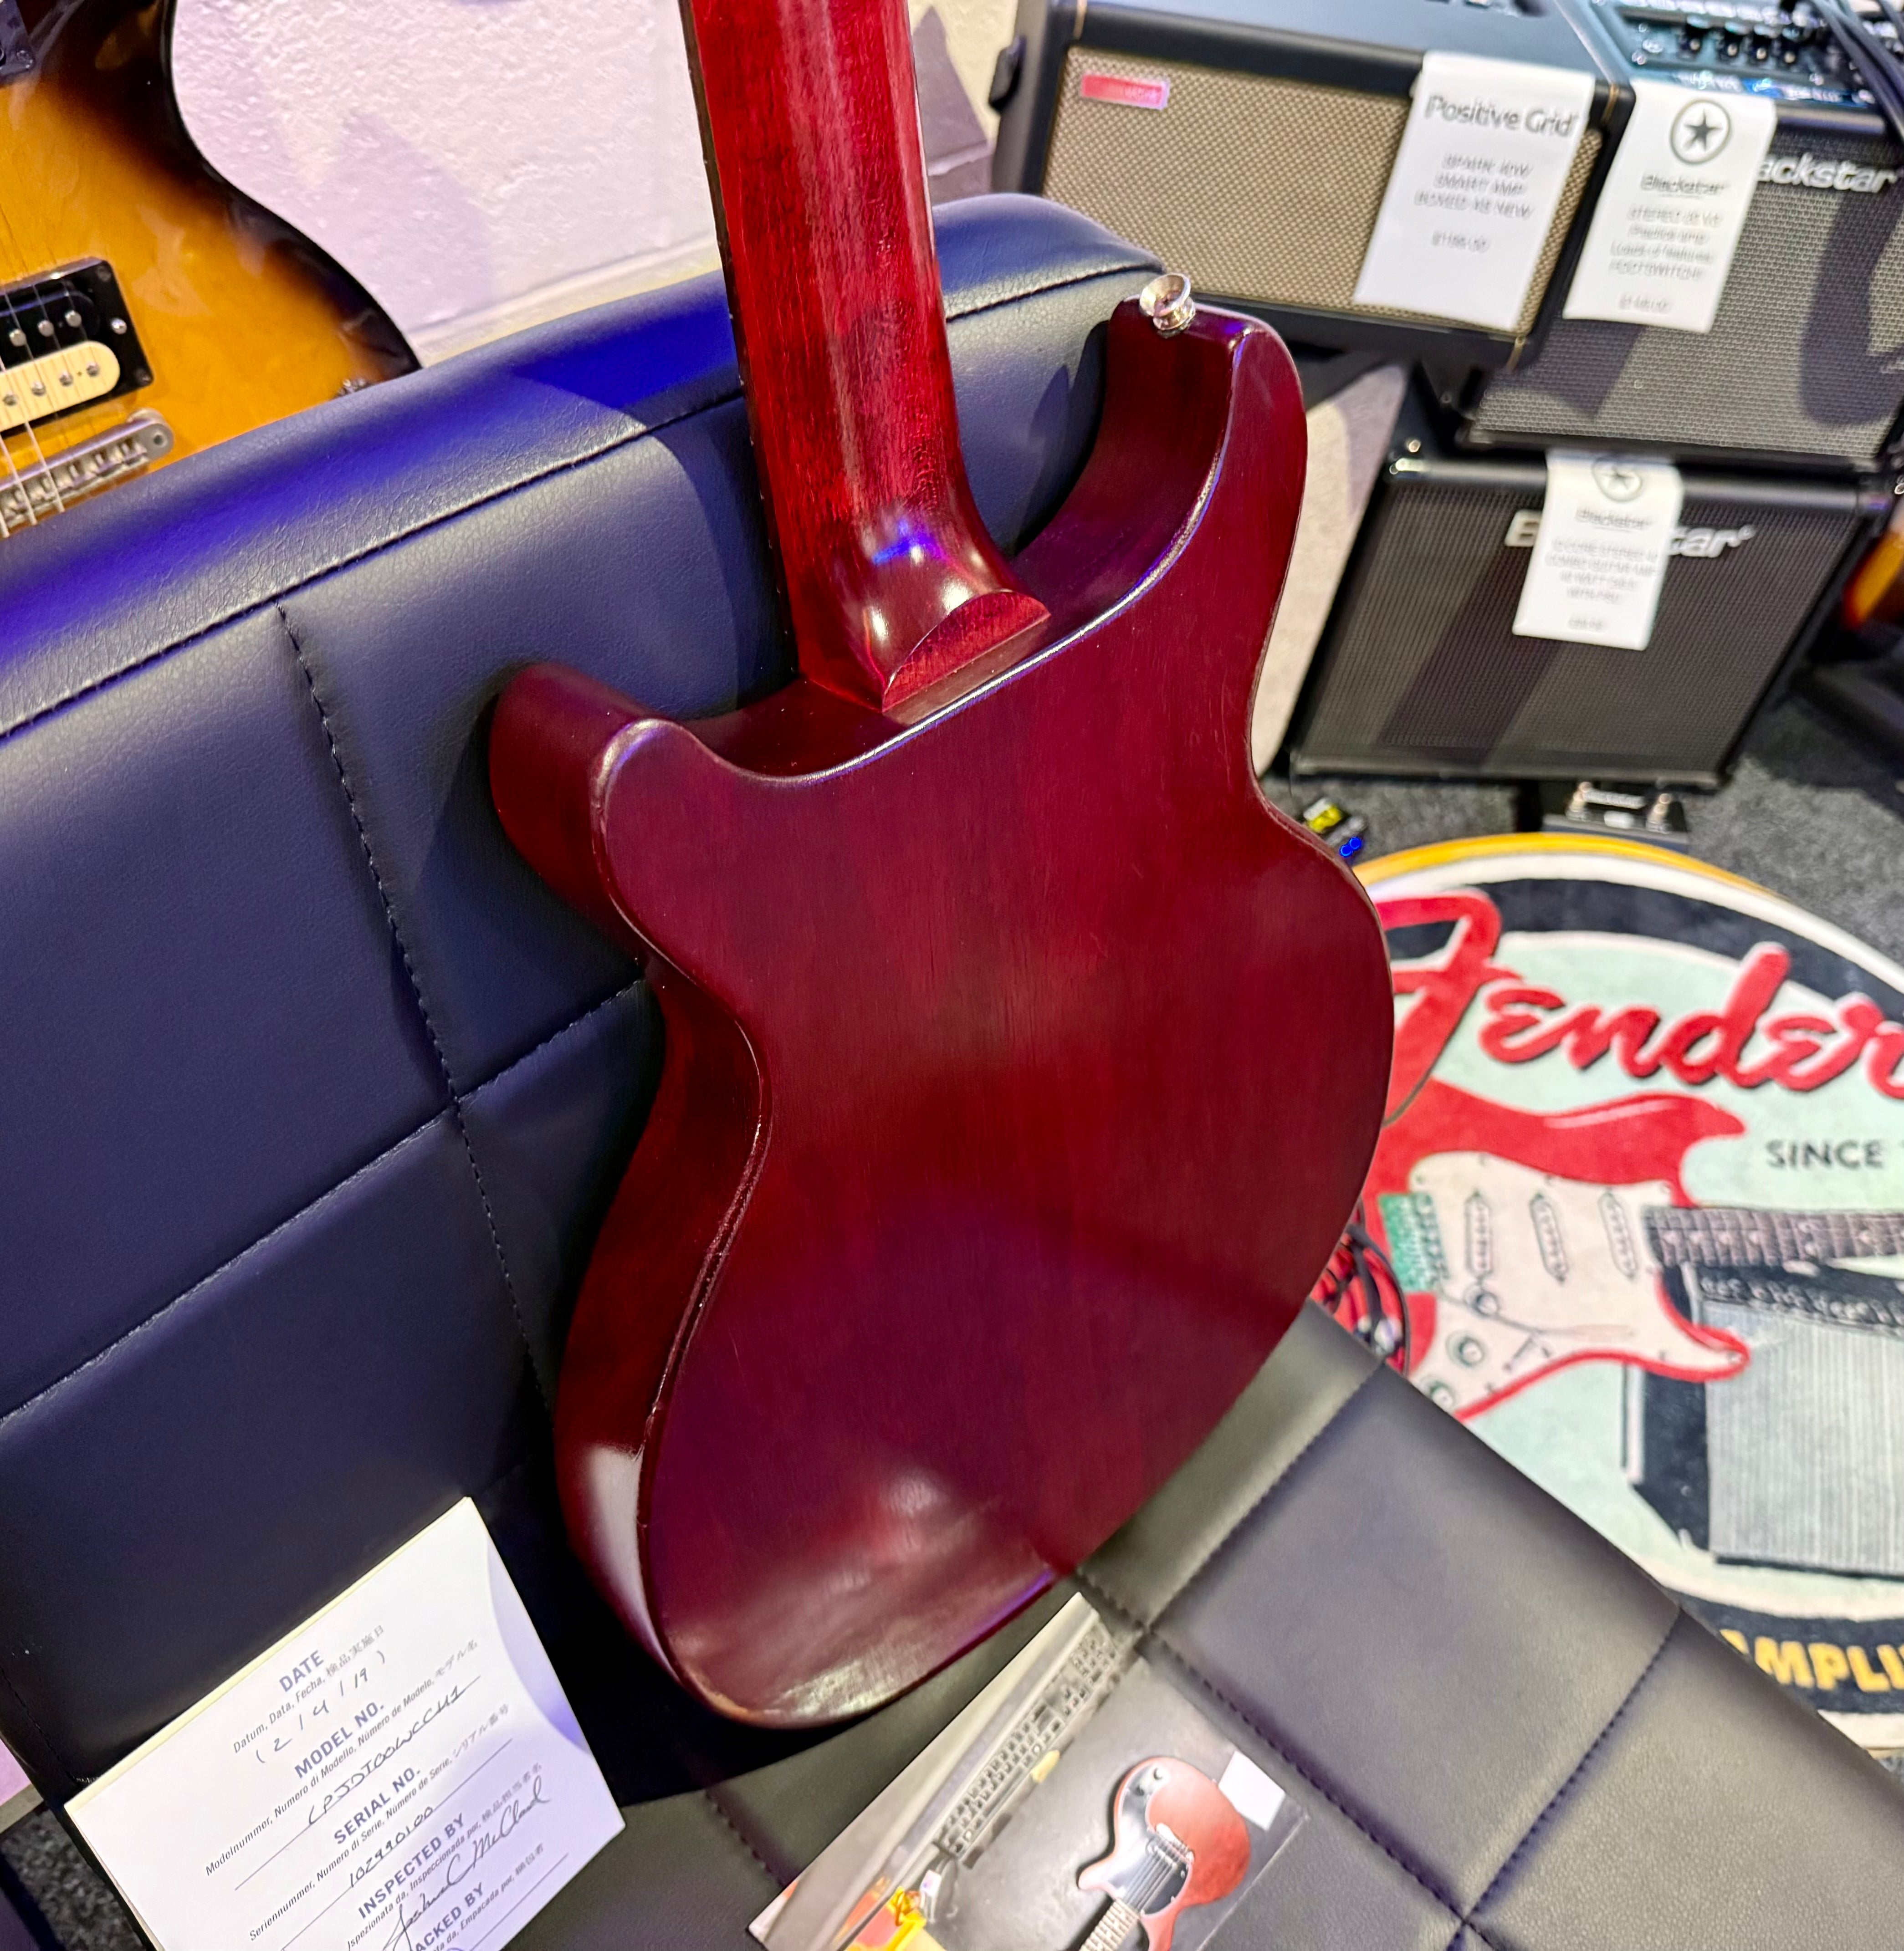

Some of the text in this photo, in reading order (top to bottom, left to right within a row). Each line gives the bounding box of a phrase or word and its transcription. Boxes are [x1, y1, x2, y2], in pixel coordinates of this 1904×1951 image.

[1424, 95, 1576, 137] Positive Grid
[1641, 173, 1725, 196] Blackstar
[1576, 507, 1650, 529] Blackstar
[1380, 888, 1904, 1101] Fender
[1765, 1139, 1884, 1170] SINCE
[279, 1650, 324, 1692] DATE
[233, 1724, 268, 1753] Datum,
[269, 1702, 294, 1725] Data,
[296, 1677, 325, 1703] Fecha,
[294, 1702, 384, 1778] MODEL NO.
[206, 1639, 478, 1876] Modelnummer, Numero di Modello, Número de Modelo, モデル名
[334, 1768, 420, 1844] SERIAL NO.
[250, 1882, 315, 1941] Seriennummer,
[317, 1849, 349, 1882] Numero
[351, 1839, 359, 1851] di
[361, 1820, 384, 1842] Serie,
[386, 1788, 416, 1819] Número
[419, 1777, 428, 1790] de
[430, 1758, 452, 1780] Serie,
[350, 1807, 434, 1888] 102990100
[358, 1813, 463, 1919] INSPECTED BY
[348, 1903, 394, 1951] Ispezionata
[396, 1891, 409, 1904] da,
[410, 1835, 465, 1891] Inspeccionada
[467, 1821, 481, 1839] por,
[447, 1931, 459, 1944] da,
[461, 1889, 499, 1931] Empacada
[501, 1875, 514, 1892] por,
[464, 1882, 483, 1907] BY
